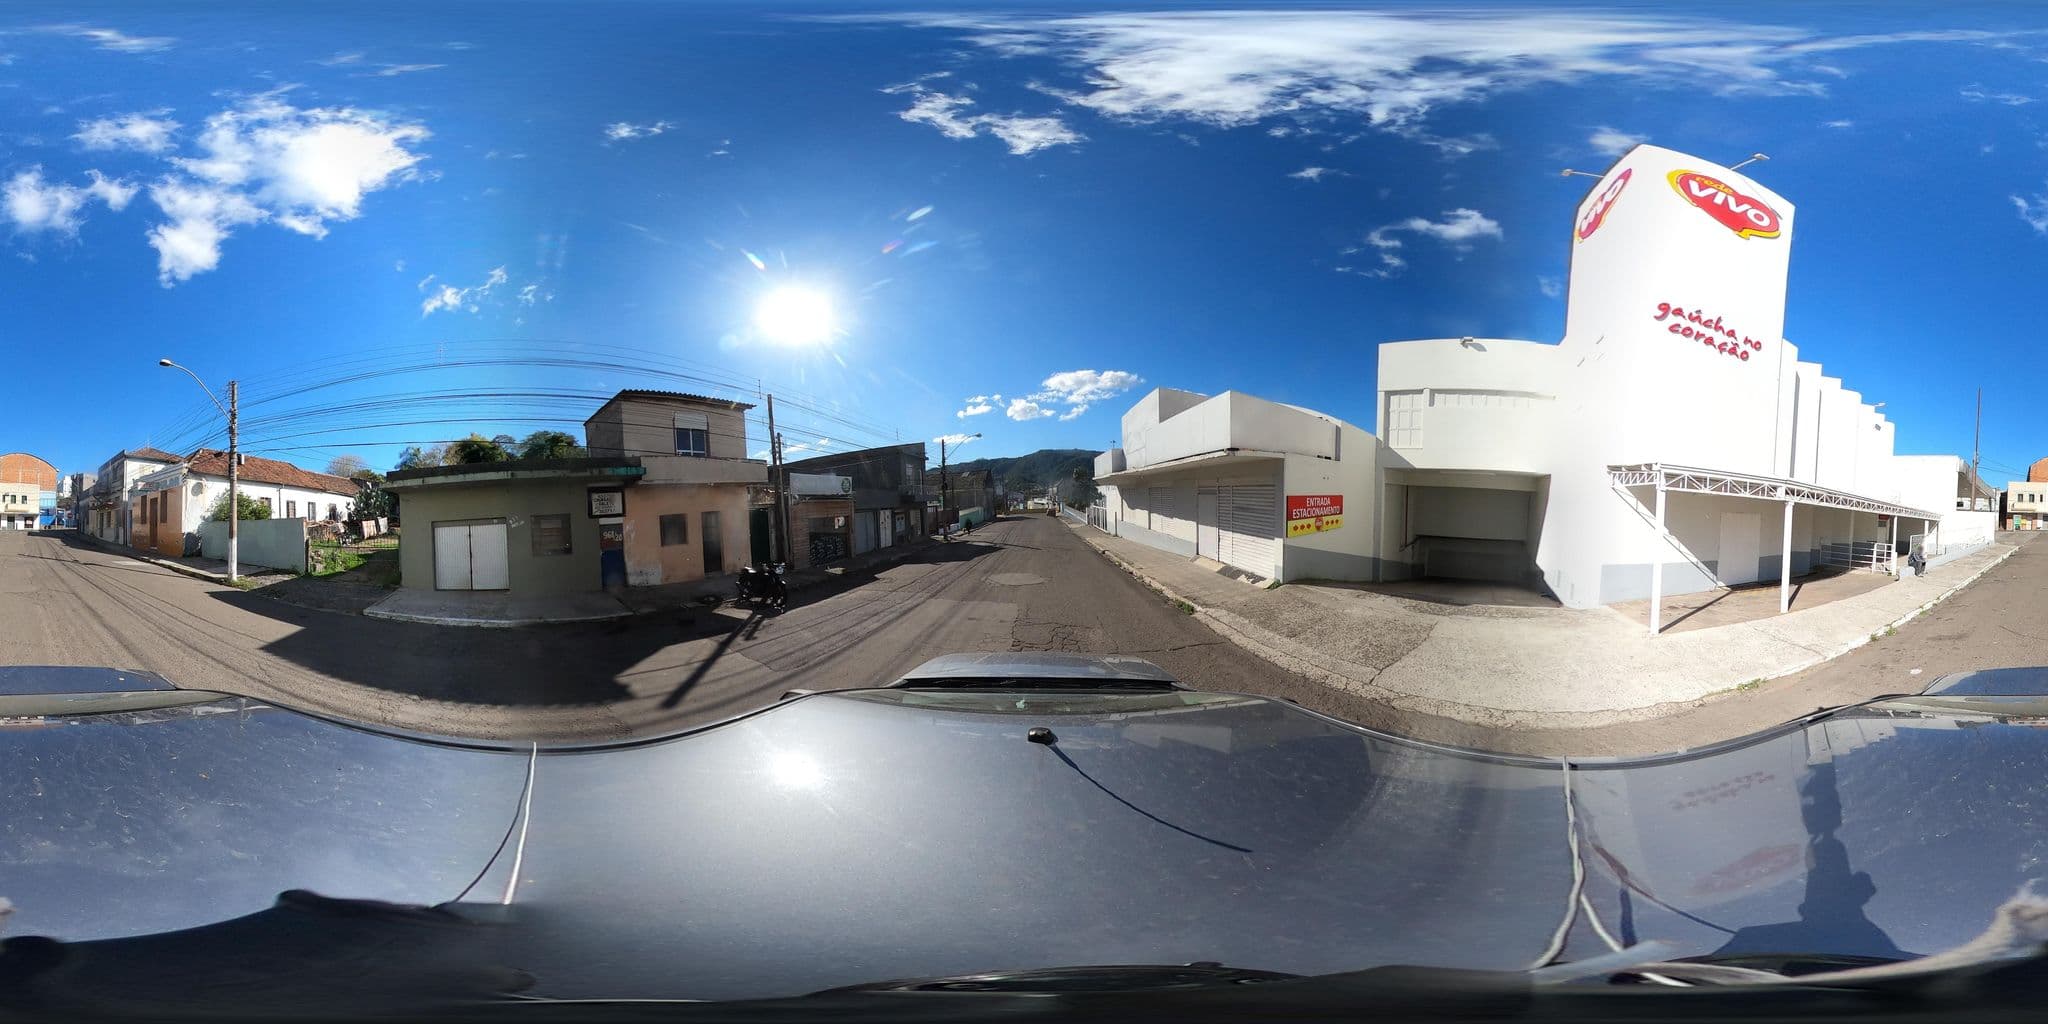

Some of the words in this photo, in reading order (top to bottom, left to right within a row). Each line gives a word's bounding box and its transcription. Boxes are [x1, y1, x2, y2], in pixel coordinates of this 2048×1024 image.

[1688, 179, 1772, 228] VIVO
[1653, 302, 1738, 342] gaúcha
[1743, 335, 1762, 352] no
[1668, 323, 1750, 362] coração
[1292, 505, 1340, 519] ESTACIONAMENTO
[1306, 497, 1331, 506] ENTRADA
